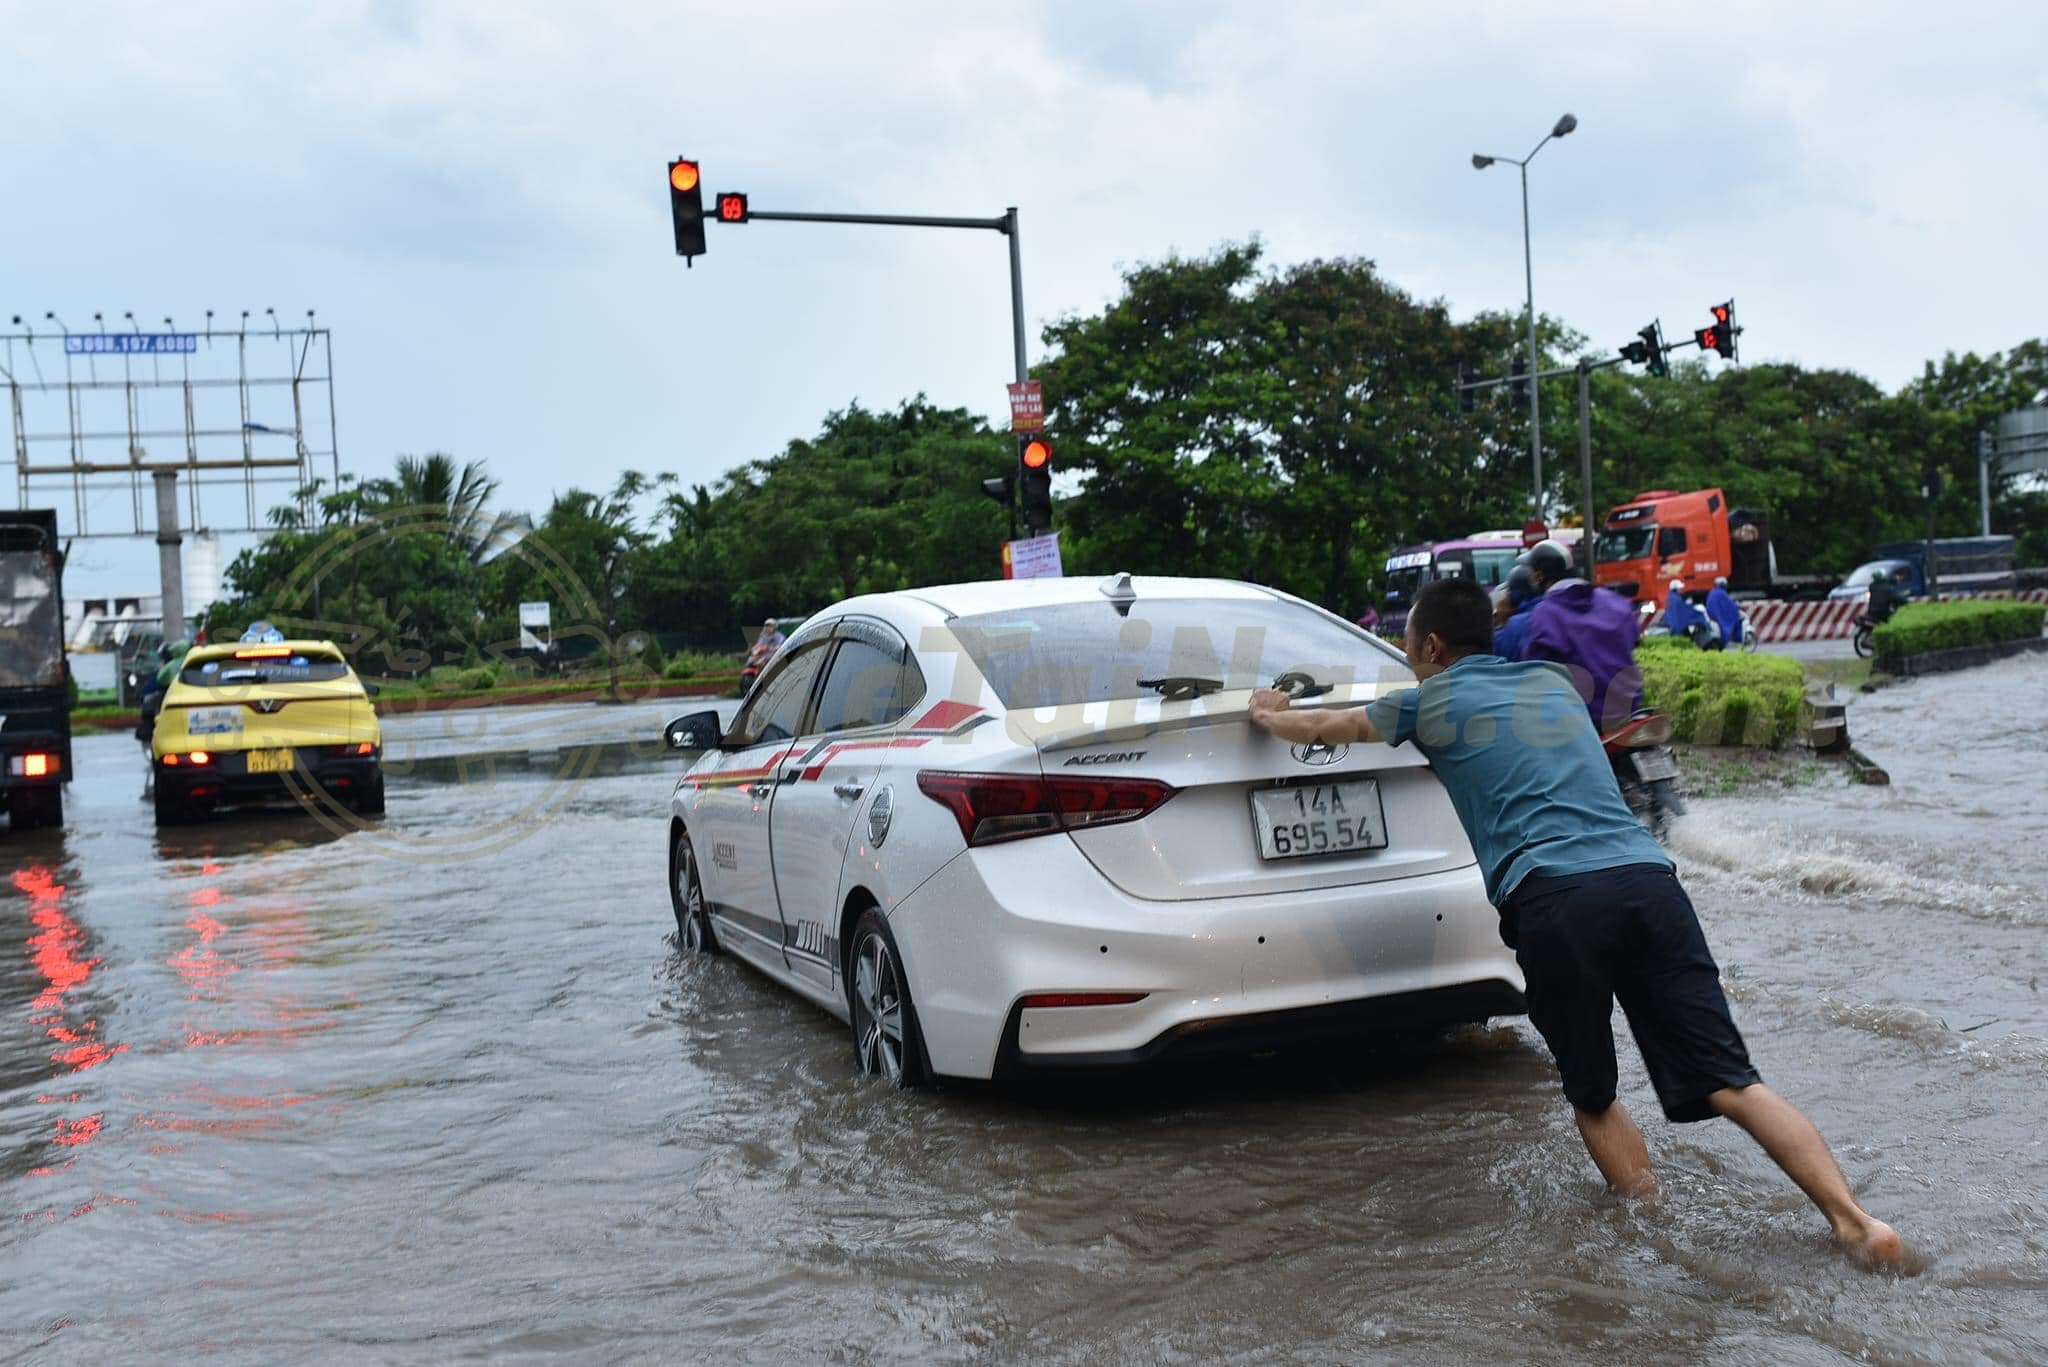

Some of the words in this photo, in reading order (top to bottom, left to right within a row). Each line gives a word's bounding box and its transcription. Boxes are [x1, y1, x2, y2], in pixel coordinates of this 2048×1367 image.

[723, 197, 742, 220] 69
[1063, 751, 1147, 767] ACCENT
[1294, 784, 1347, 818] 14A
[1273, 815, 1373, 854] 695.54
